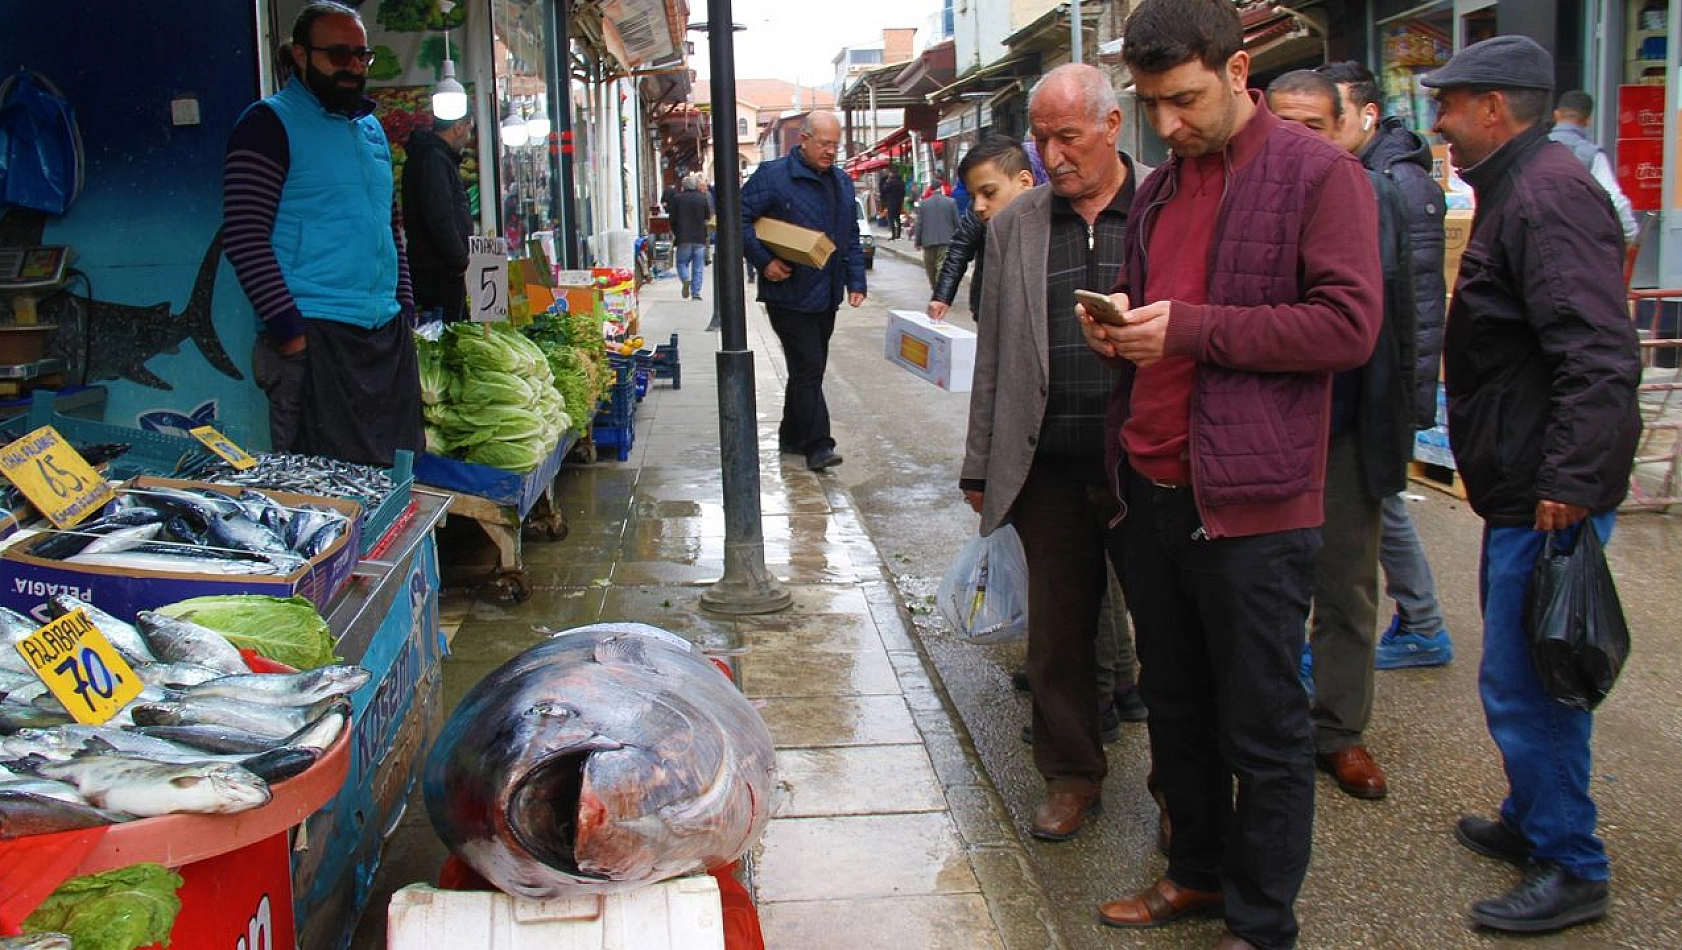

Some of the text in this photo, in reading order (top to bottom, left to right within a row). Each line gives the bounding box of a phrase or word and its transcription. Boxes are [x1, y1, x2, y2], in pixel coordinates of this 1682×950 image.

[480, 265, 499, 311] 5
[14, 577, 92, 602] PELAGIA
[22, 611, 95, 670] ALABALIK
